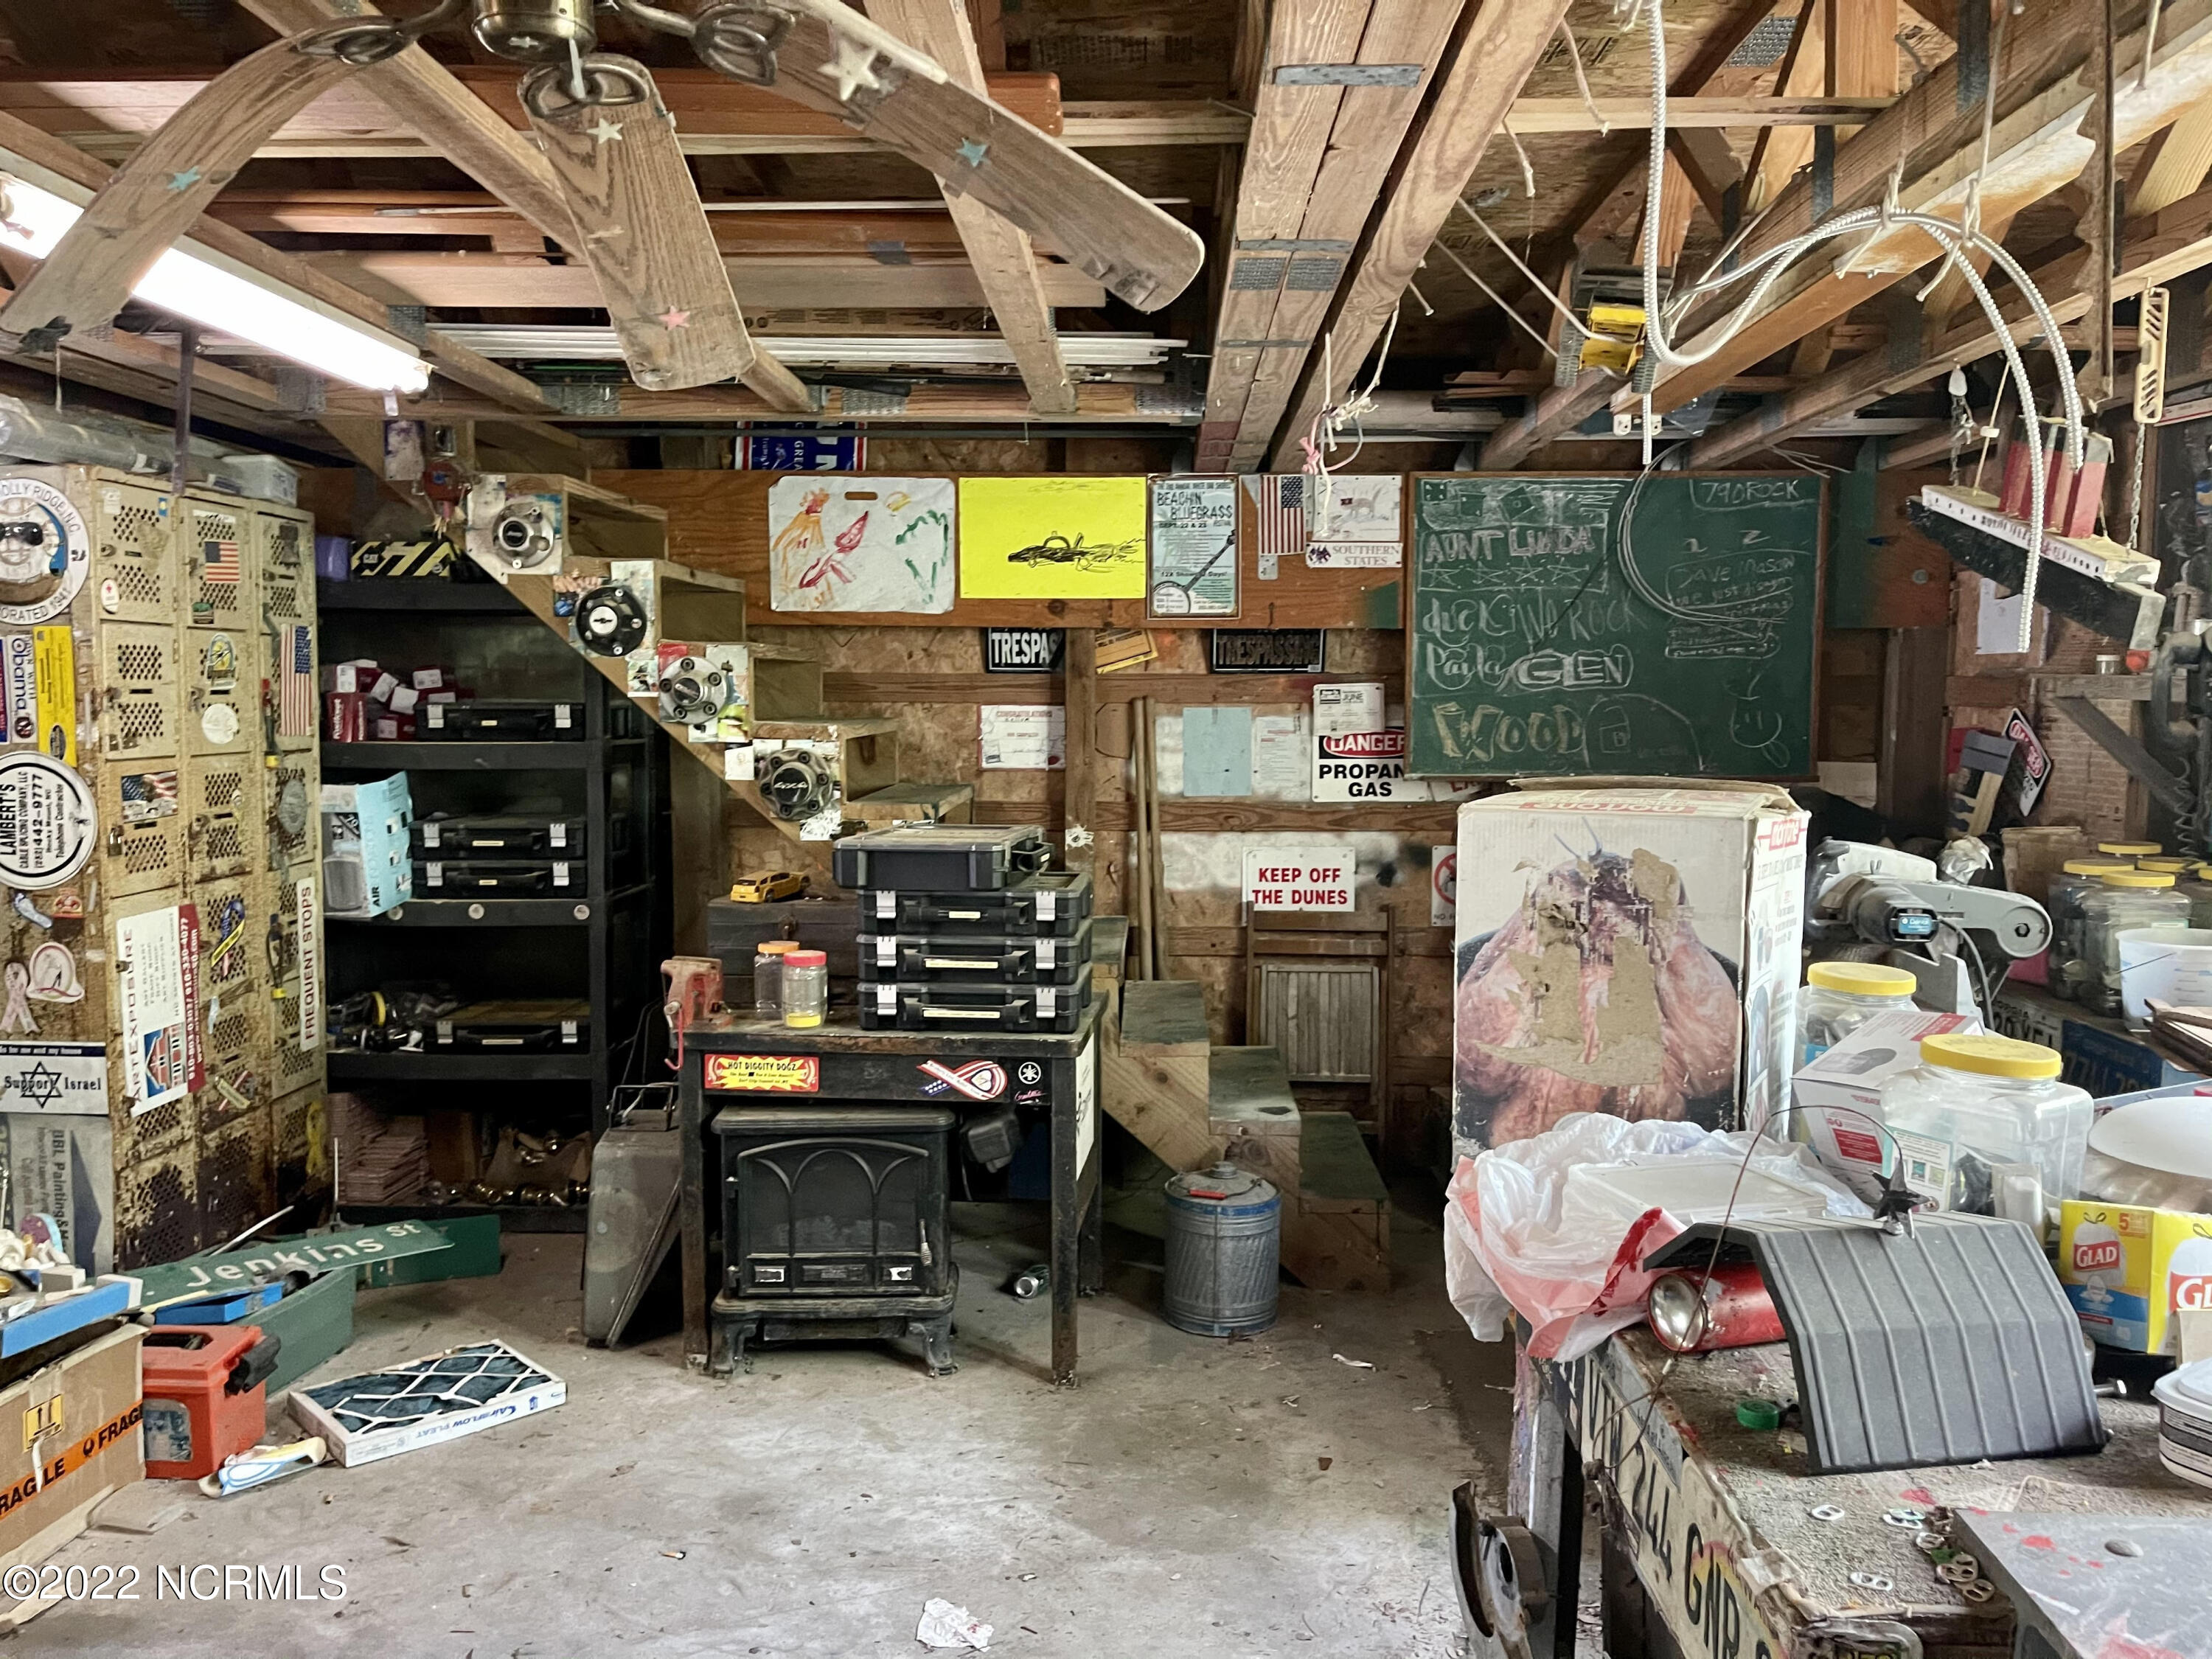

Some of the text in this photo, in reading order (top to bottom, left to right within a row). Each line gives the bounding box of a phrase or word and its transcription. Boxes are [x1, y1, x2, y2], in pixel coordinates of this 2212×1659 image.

[0, 484, 31, 497] OLLY
[1333, 545, 1399, 555] SOUTHERN
[1345, 557, 1388, 566] STATES
[12, 638, 27, 709] Obama
[1348, 782, 1393, 797] GAS
[0, 784, 16, 855] LAMBERT'S
[1259, 867, 1341, 883] KEEP OFF
[372, 886, 380, 907] AIR
[1253, 889, 1348, 905] THE DUNES
[302, 887, 316, 1040] FREQUENT STOPS
[745, 1062, 773, 1070] DIGGITY
[4, 1076, 102, 1093] Support Israel
[2119, 1213, 2129, 1231] 5
[187, 1221, 421, 1289] Jenkins St
[2076, 1246, 2118, 1267] GLAD
[2177, 1278, 2212, 1310] GL
[0, 1404, 143, 1516] RAGLE FRAG
